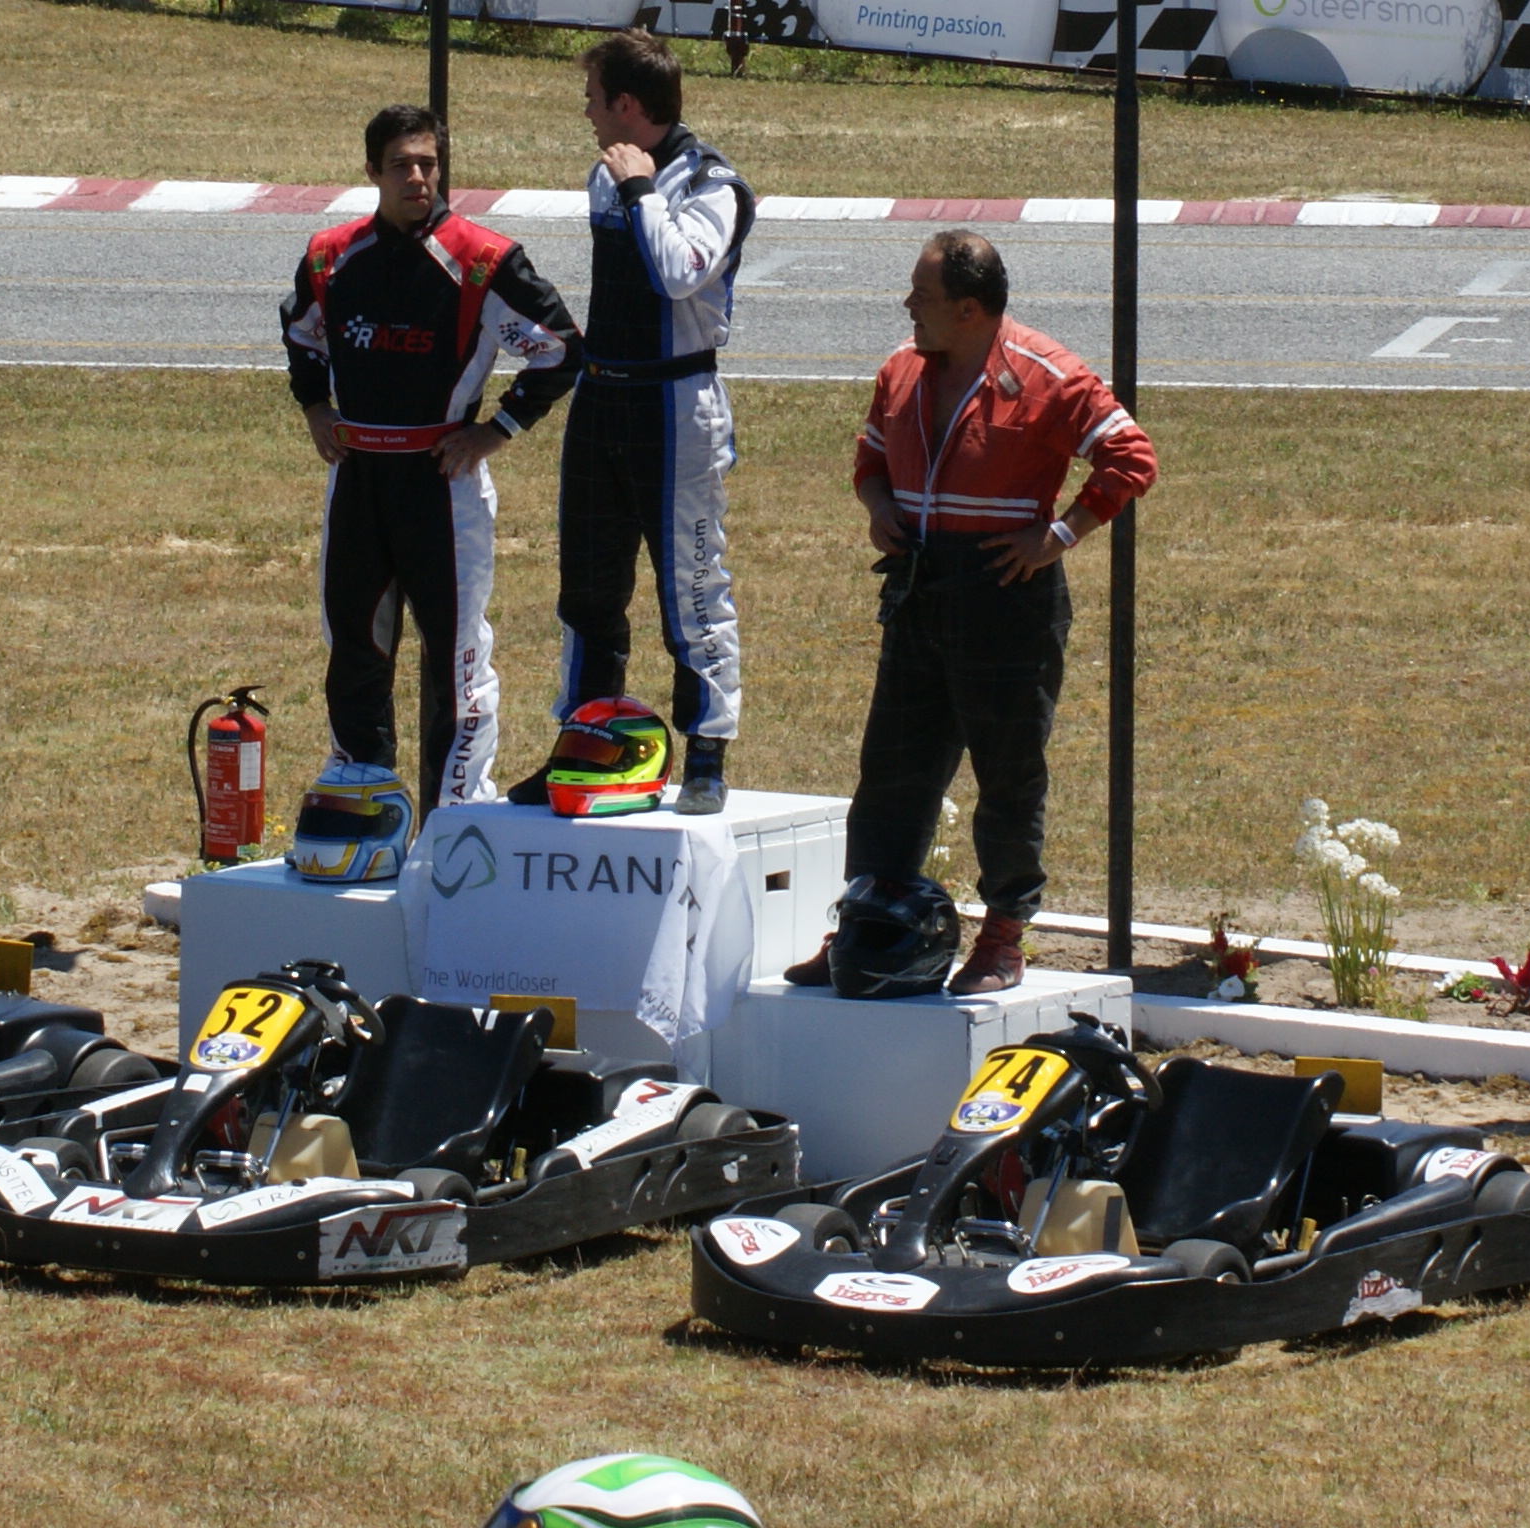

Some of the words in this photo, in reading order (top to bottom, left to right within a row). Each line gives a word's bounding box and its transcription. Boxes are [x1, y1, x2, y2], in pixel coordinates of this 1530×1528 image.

[856, 5, 929, 38] Printing
[932, 14, 1007, 39] passion.
[455, 969, 506, 991] World
[507, 972, 560, 992] Closer
[207, 991, 283, 1040] 52
[967, 1051, 1048, 1100] 74
[334, 1203, 458, 1259] NKT
